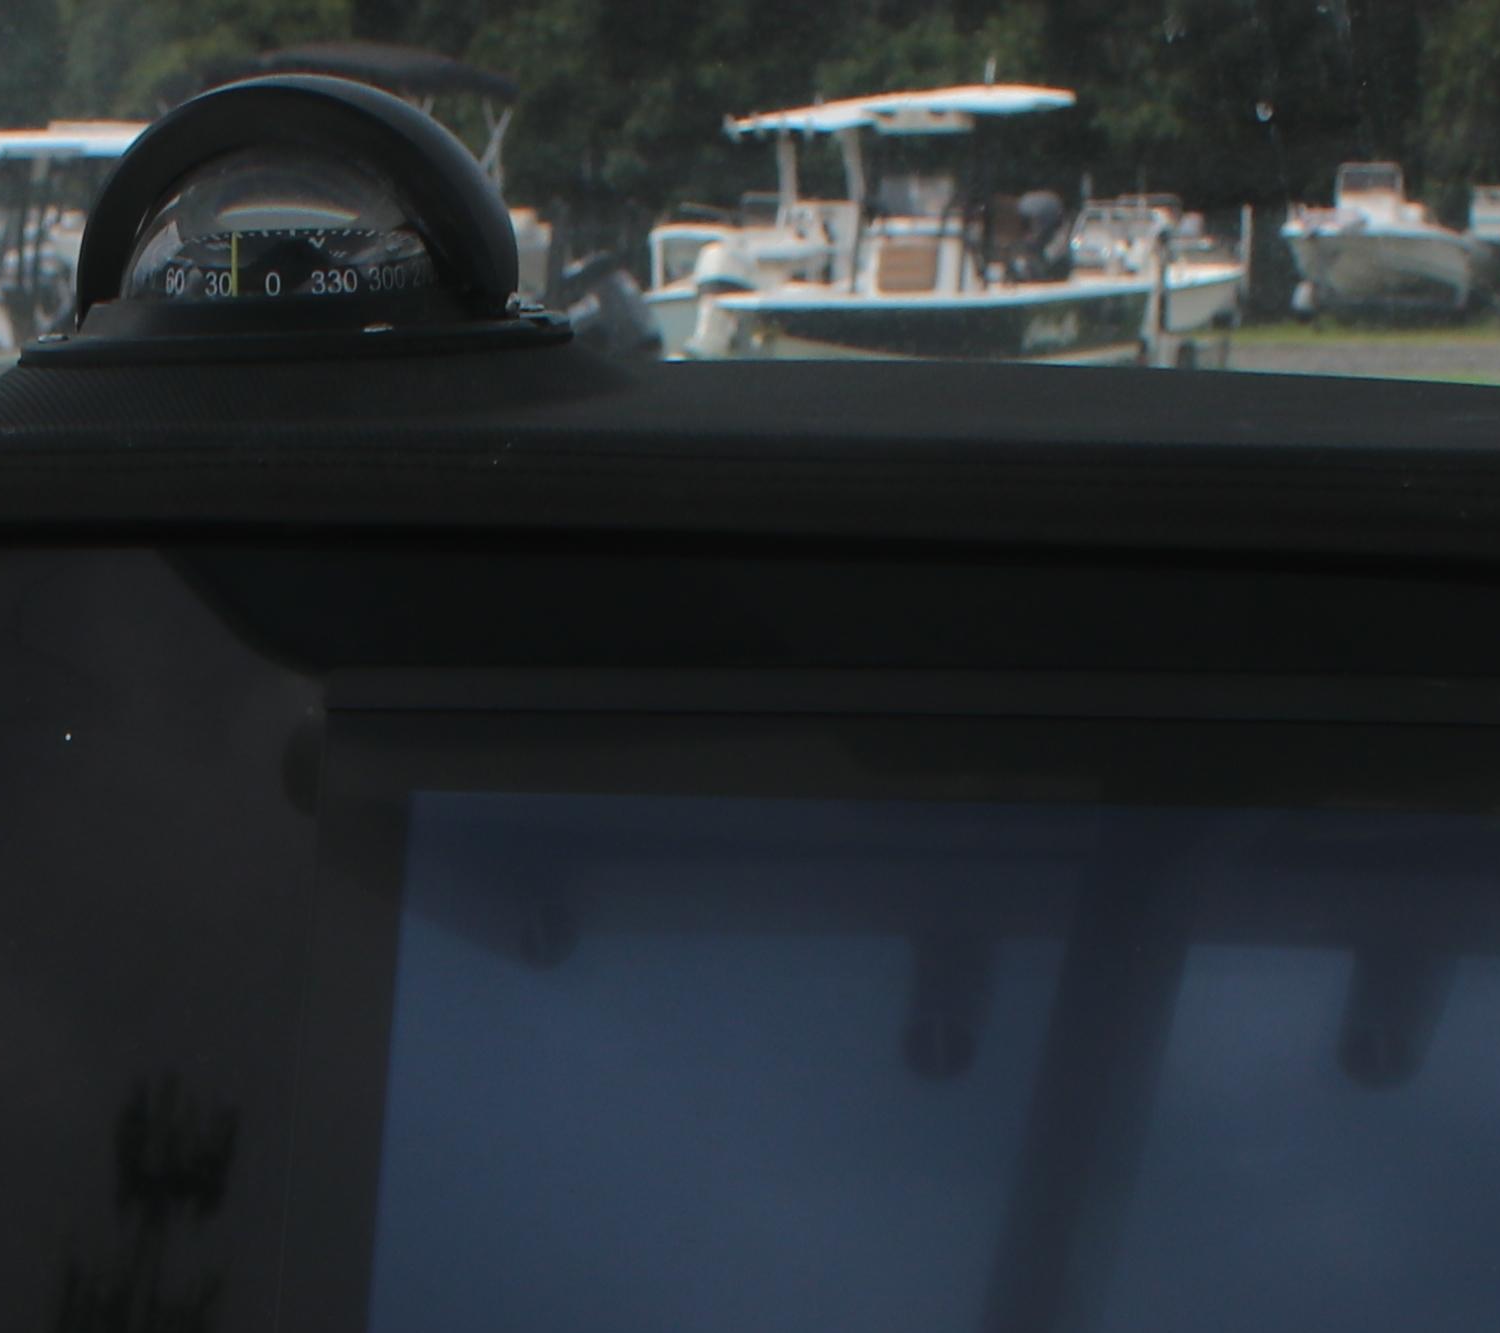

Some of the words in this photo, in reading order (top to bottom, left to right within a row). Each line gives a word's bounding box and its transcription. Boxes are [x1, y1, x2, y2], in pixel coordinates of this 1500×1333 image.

[165, 267, 184, 294] 60
[205, 271, 232, 297] 30
[264, 272, 281, 297] 0
[311, 270, 358, 294] 330
